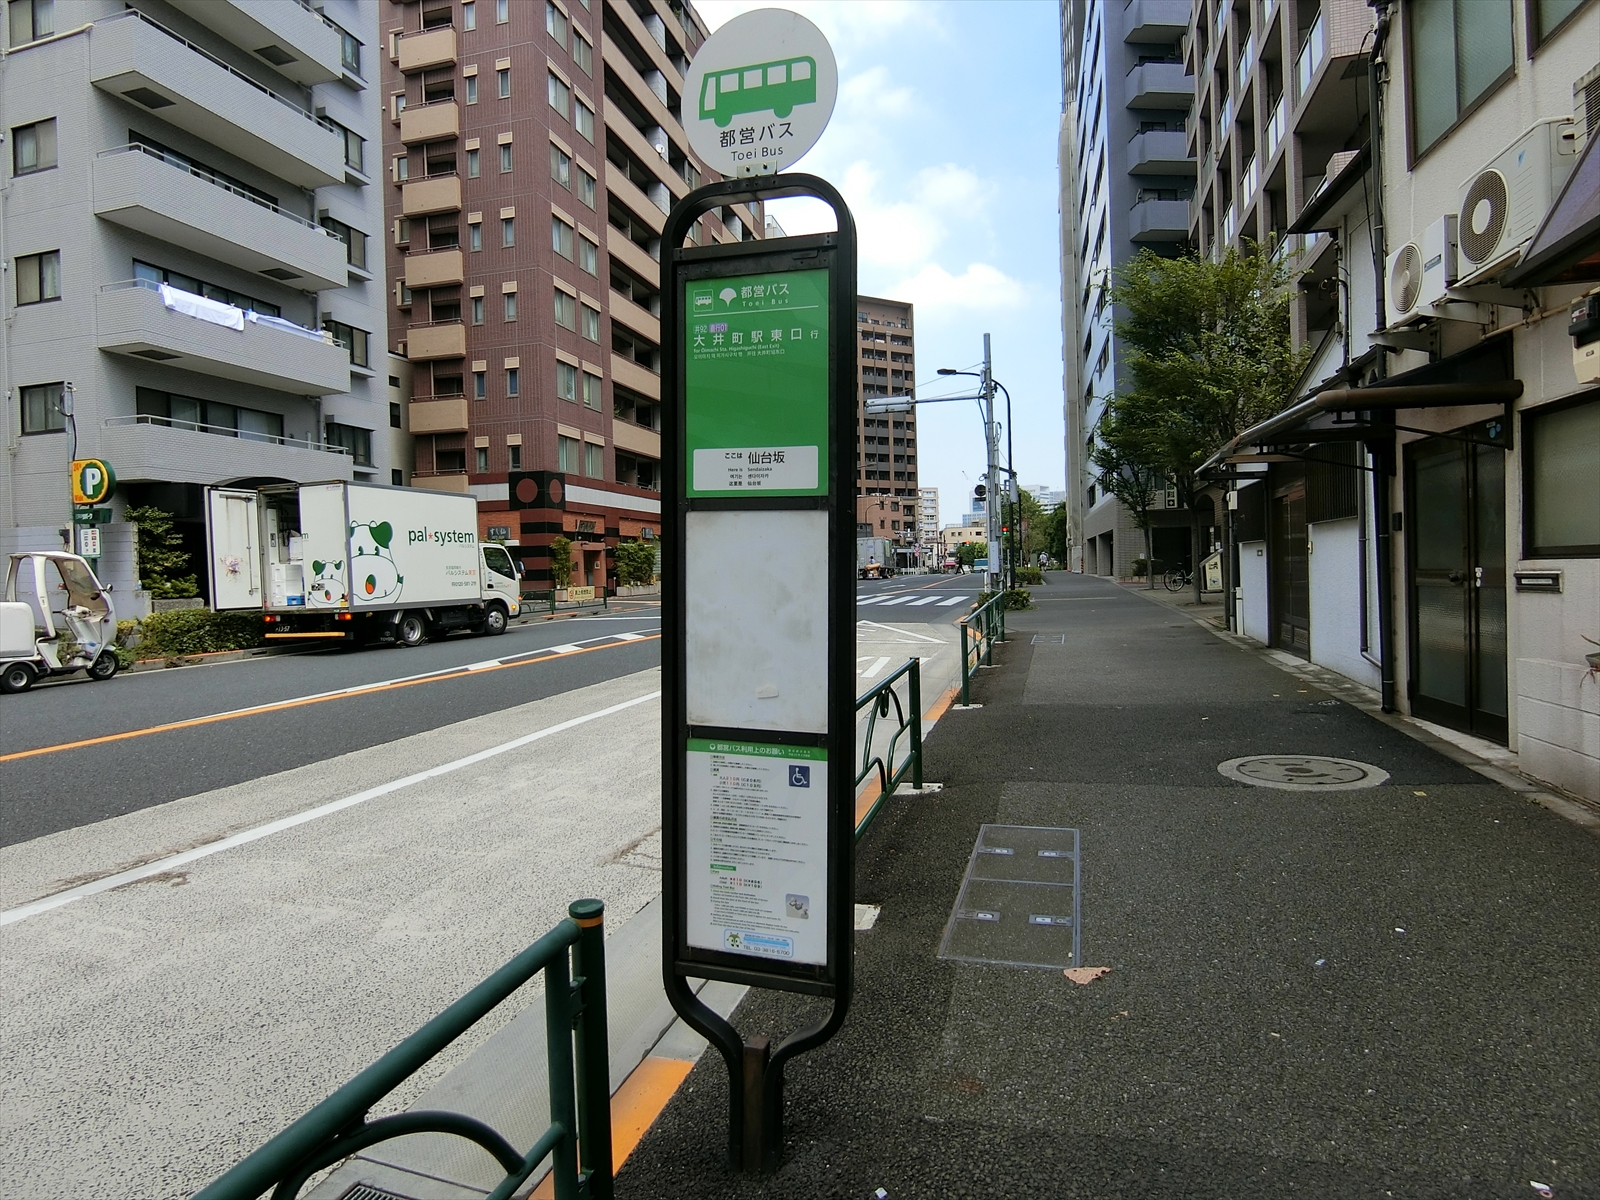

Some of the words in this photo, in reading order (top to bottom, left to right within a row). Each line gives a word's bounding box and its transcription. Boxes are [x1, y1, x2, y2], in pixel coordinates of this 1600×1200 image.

[720, 122, 794, 148] 都営バス
[731, 149, 757, 161] Toei
[761, 146, 784, 158] Bus
[741, 284, 790, 299] 都営バス
[724, 452, 743, 460] ここは
[747, 451, 785, 465] 仙台坂
[86, 468, 101, 495] P
[408, 526, 427, 546] pal
[434, 530, 475, 547] system
[717, 743, 785, 755] 都営バス利用上のお願い
